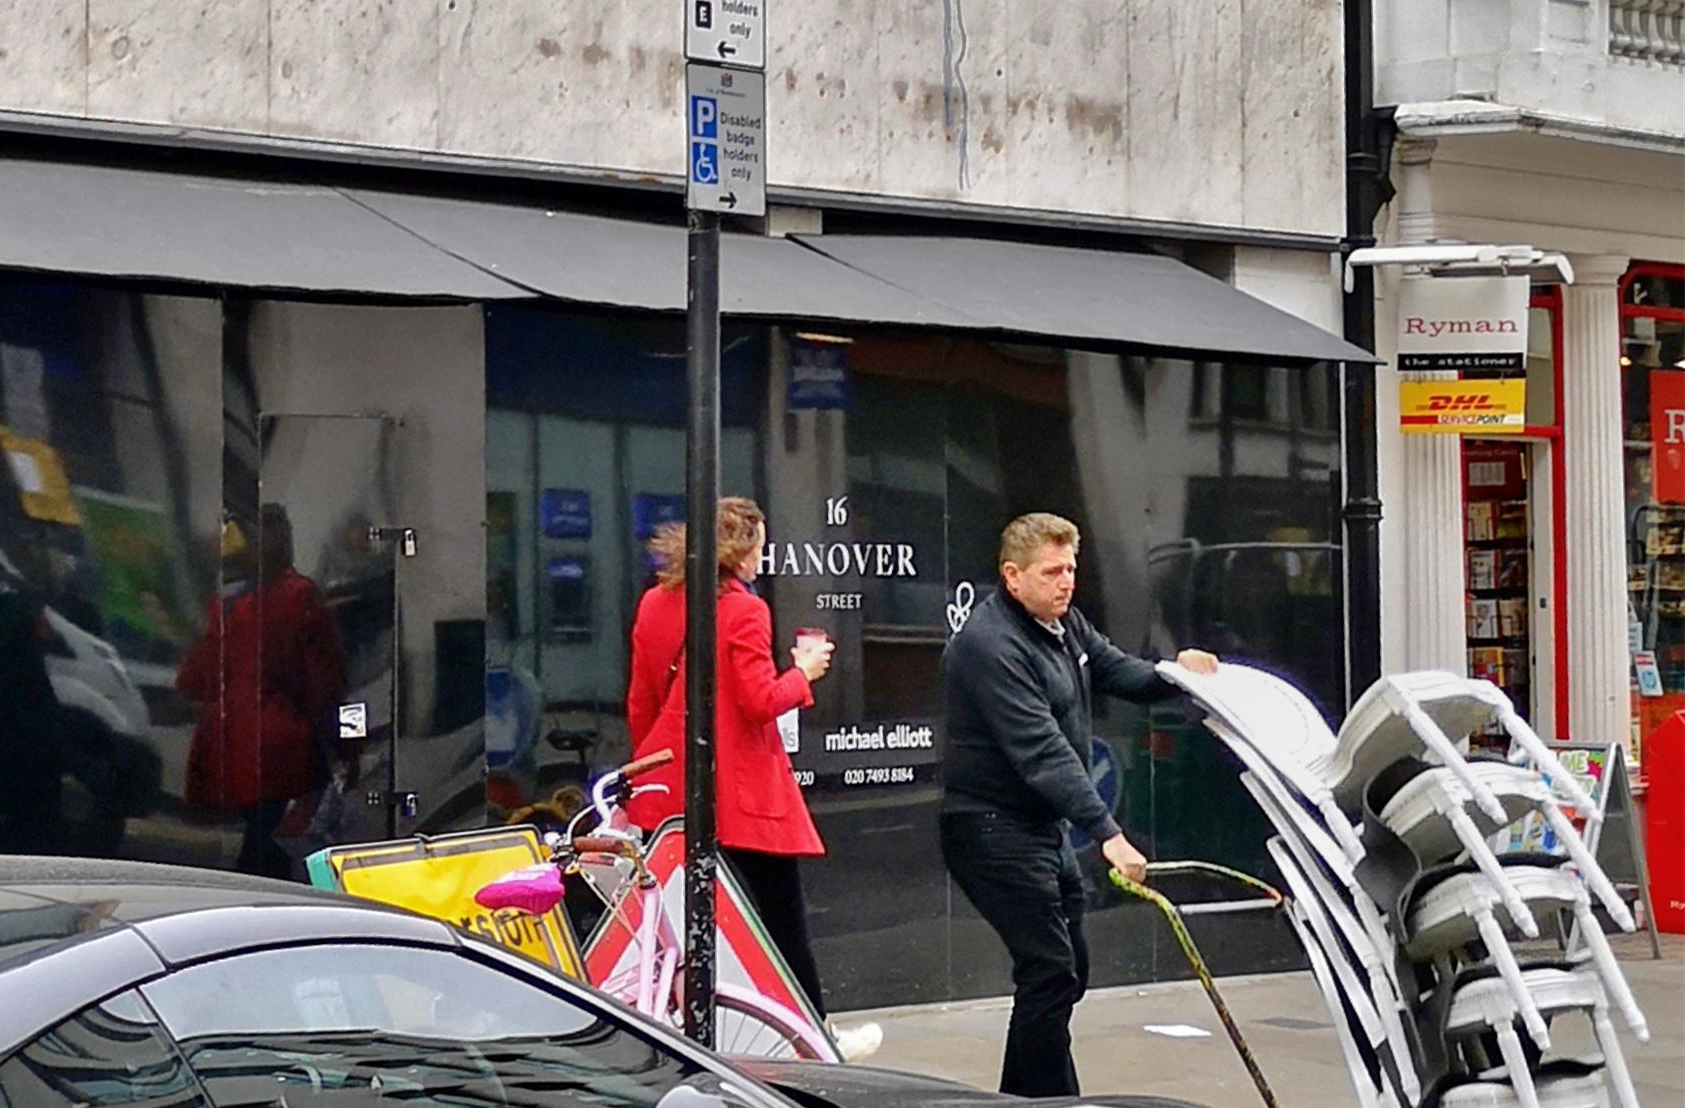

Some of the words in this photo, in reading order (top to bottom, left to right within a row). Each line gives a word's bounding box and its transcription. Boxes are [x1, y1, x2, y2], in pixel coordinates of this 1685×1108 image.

[729, 22, 751, 39] only
[696, 100, 715, 135] P
[720, 112, 761, 130] Disabled
[726, 130, 755, 147] badge
[723, 147, 758, 163] holders
[731, 167, 751, 181] only
[1404, 317, 1518, 337] Ryman
[1404, 357, 1430, 366] the
[1428, 394, 1493, 411] DHL
[826, 496, 849, 526] 16
[757, 542, 917, 576] HANOVER
[816, 593, 863, 610] STREET
[825, 726, 885, 751] michael
[886, 724, 933, 749] elliott
[844, 770, 865, 785] 020
[865, 768, 889, 783] 7493
[891, 767, 914, 782] 8184
